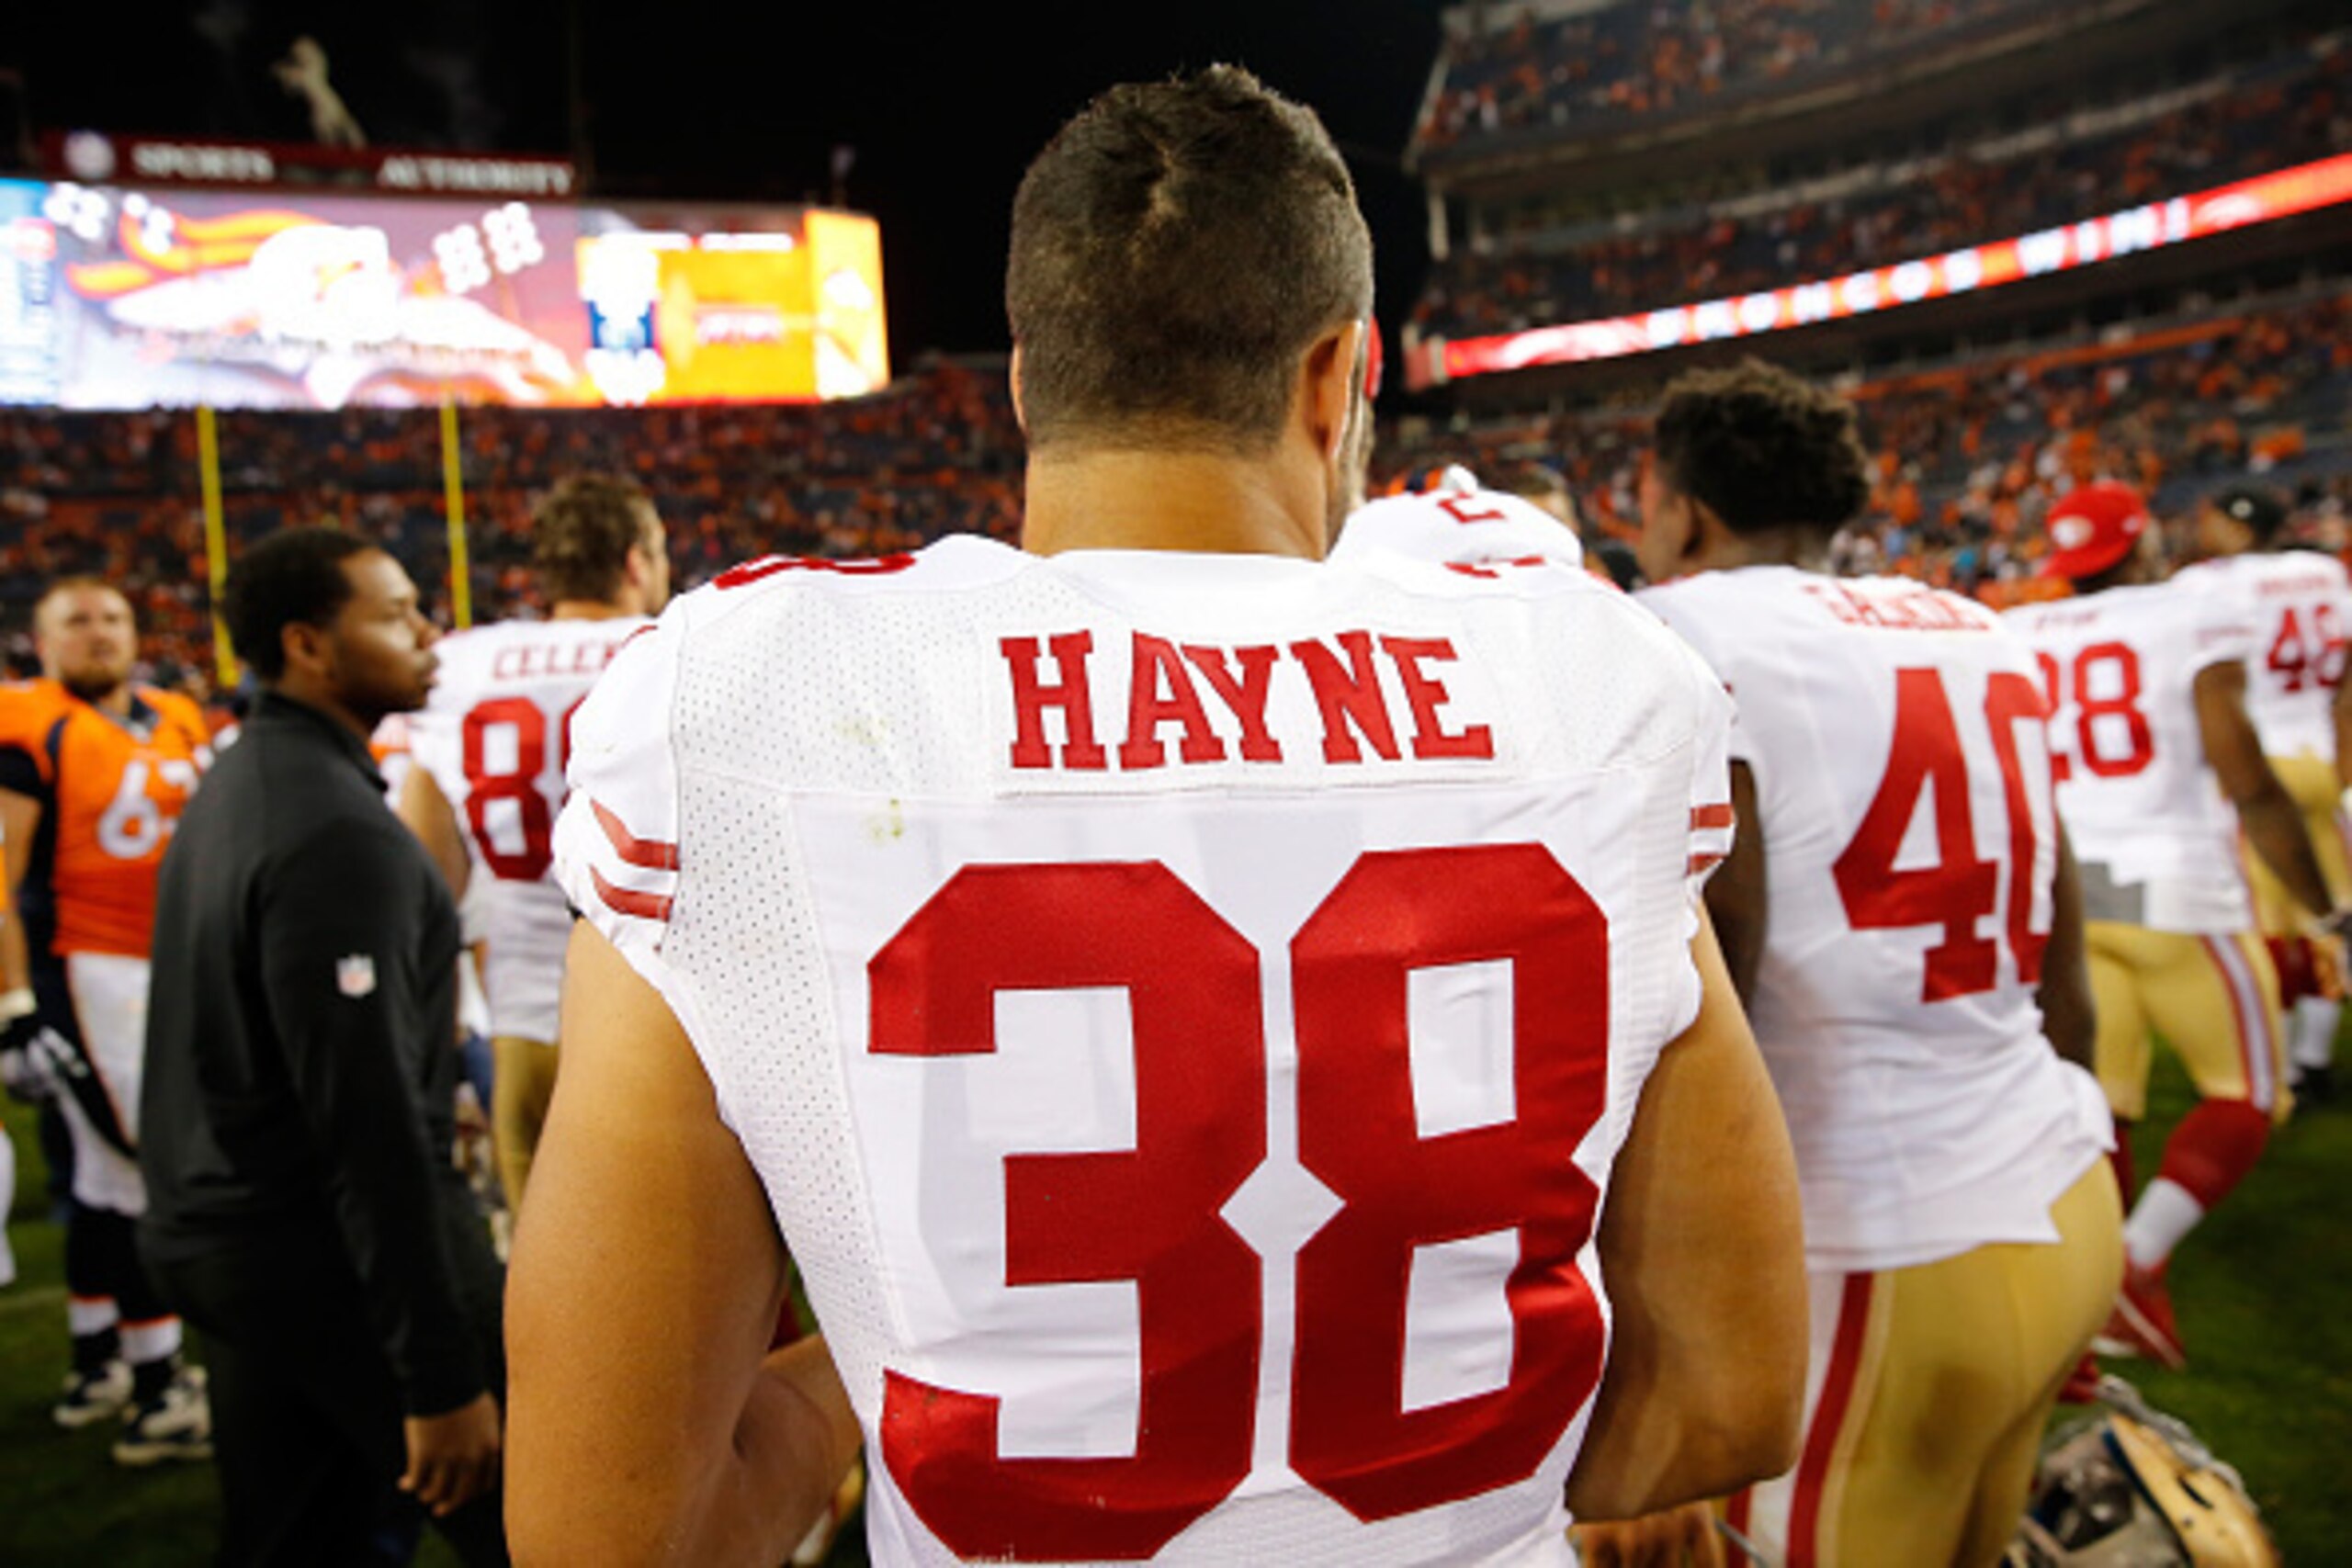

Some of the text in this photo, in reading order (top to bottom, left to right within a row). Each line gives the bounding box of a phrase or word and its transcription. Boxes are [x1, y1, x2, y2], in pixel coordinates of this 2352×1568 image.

[462, 695, 588, 882] 8
[1001, 630, 1494, 770] HAYNE
[867, 841, 1611, 1563] 38
